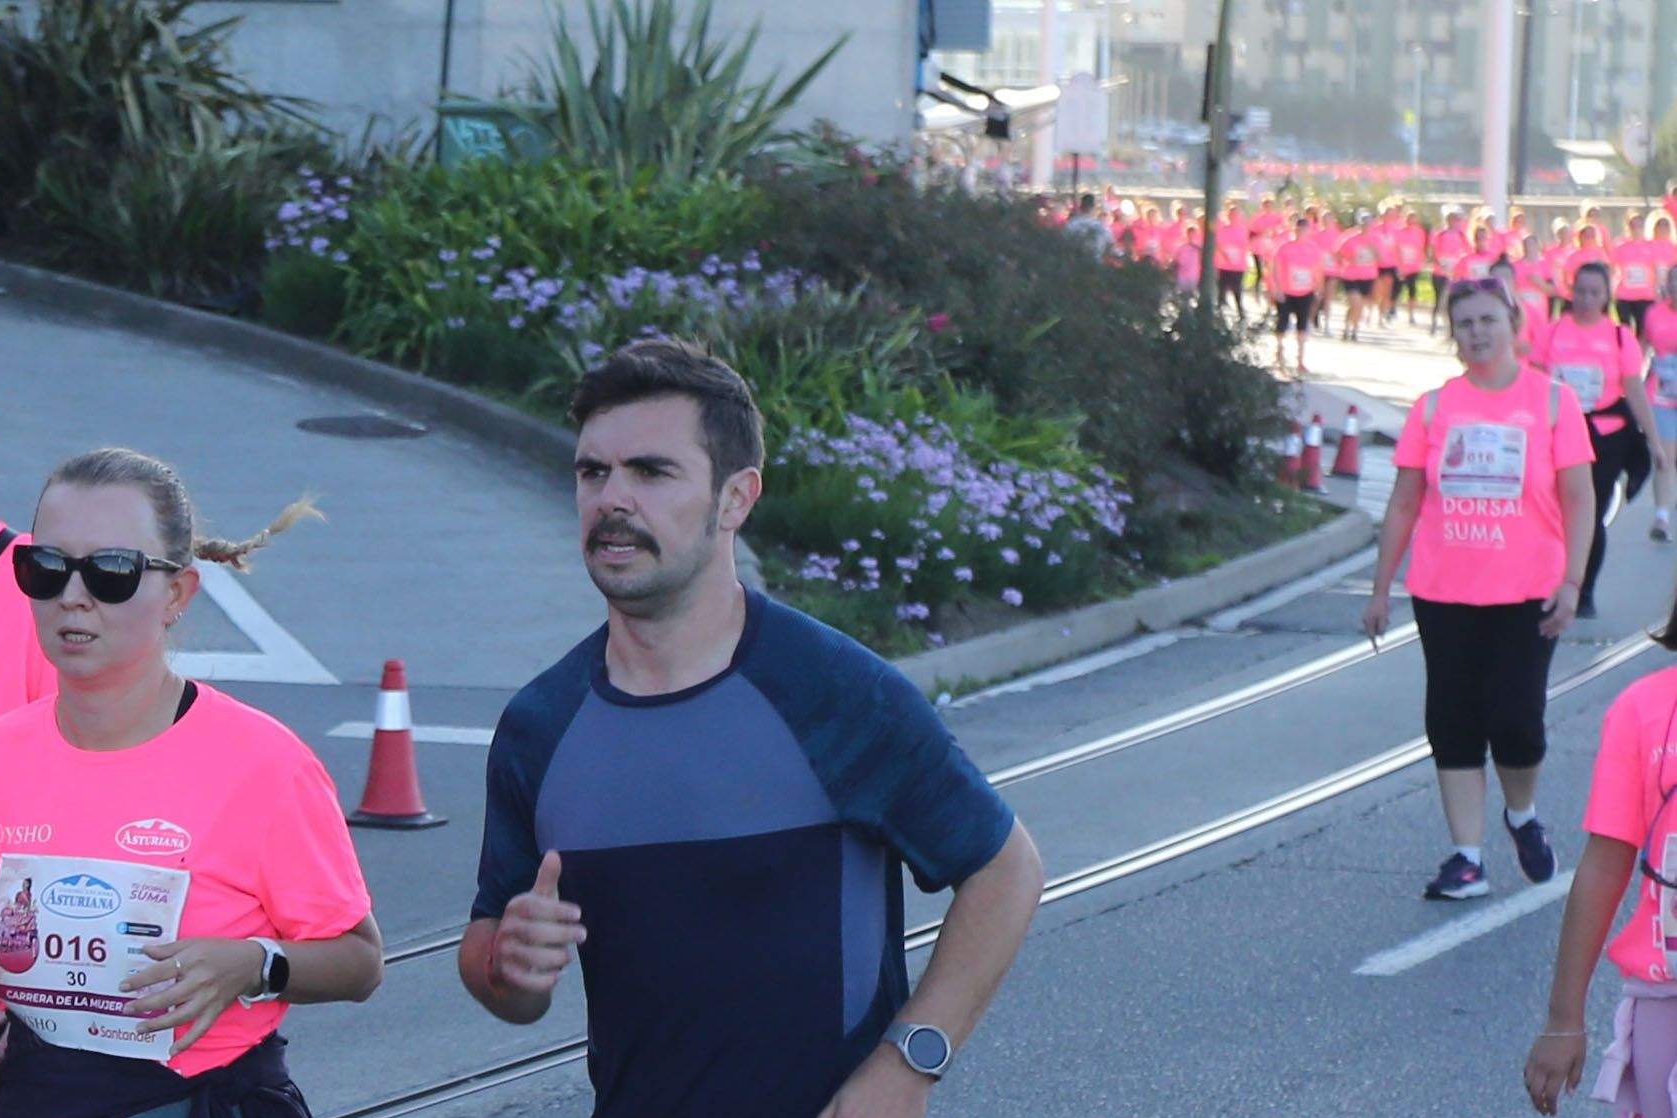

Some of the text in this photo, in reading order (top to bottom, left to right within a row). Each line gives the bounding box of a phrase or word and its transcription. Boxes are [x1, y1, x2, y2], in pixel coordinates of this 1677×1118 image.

[1443, 523, 1506, 543] SUMA
[122, 831, 185, 849] ASTURIANA
[44, 889, 114, 911] ASTURIANA
[128, 890, 168, 905] SUMA
[44, 933, 107, 963] 016
[66, 970, 87, 987] 30
[5, 989, 124, 1012] CARRERA DE LA MUJER
